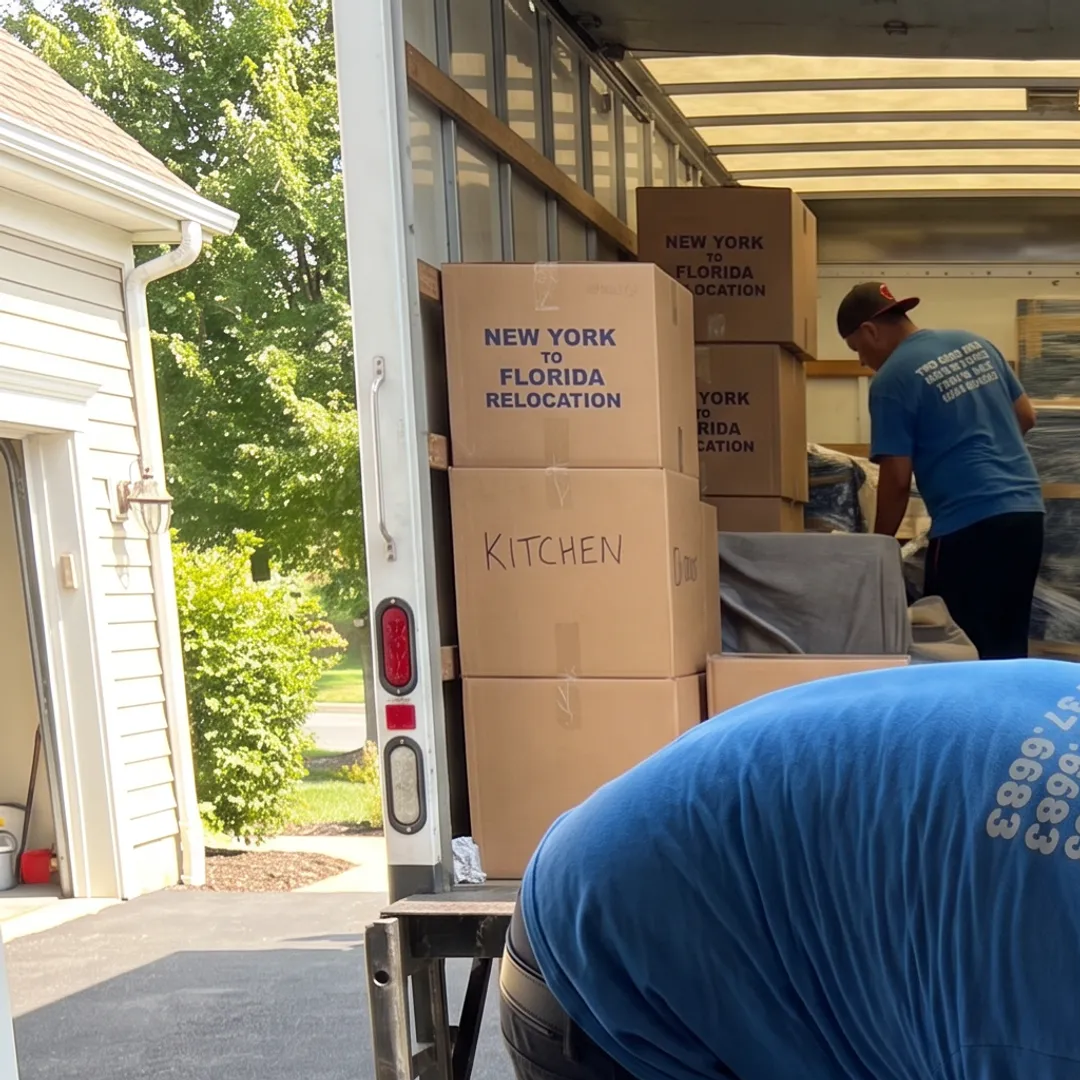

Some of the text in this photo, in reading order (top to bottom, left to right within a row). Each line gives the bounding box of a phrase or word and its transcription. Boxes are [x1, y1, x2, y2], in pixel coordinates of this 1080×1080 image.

[665, 235, 764, 250] NEW YORK
[706, 252, 723, 262] TO
[676, 265, 754, 279] FLORIDA
[686, 284, 766, 297] OCATION
[484, 328, 616, 346] NEW YORK
[540, 351, 563, 364] TO
[500, 368, 605, 386] FLORIDA
[486, 392, 621, 409] RELOCATION
[698, 391, 750, 406] YORK
[697, 422, 742, 435] RIDA
[697, 440, 755, 453] CATION
[484, 532, 623, 571] KITCHEN
